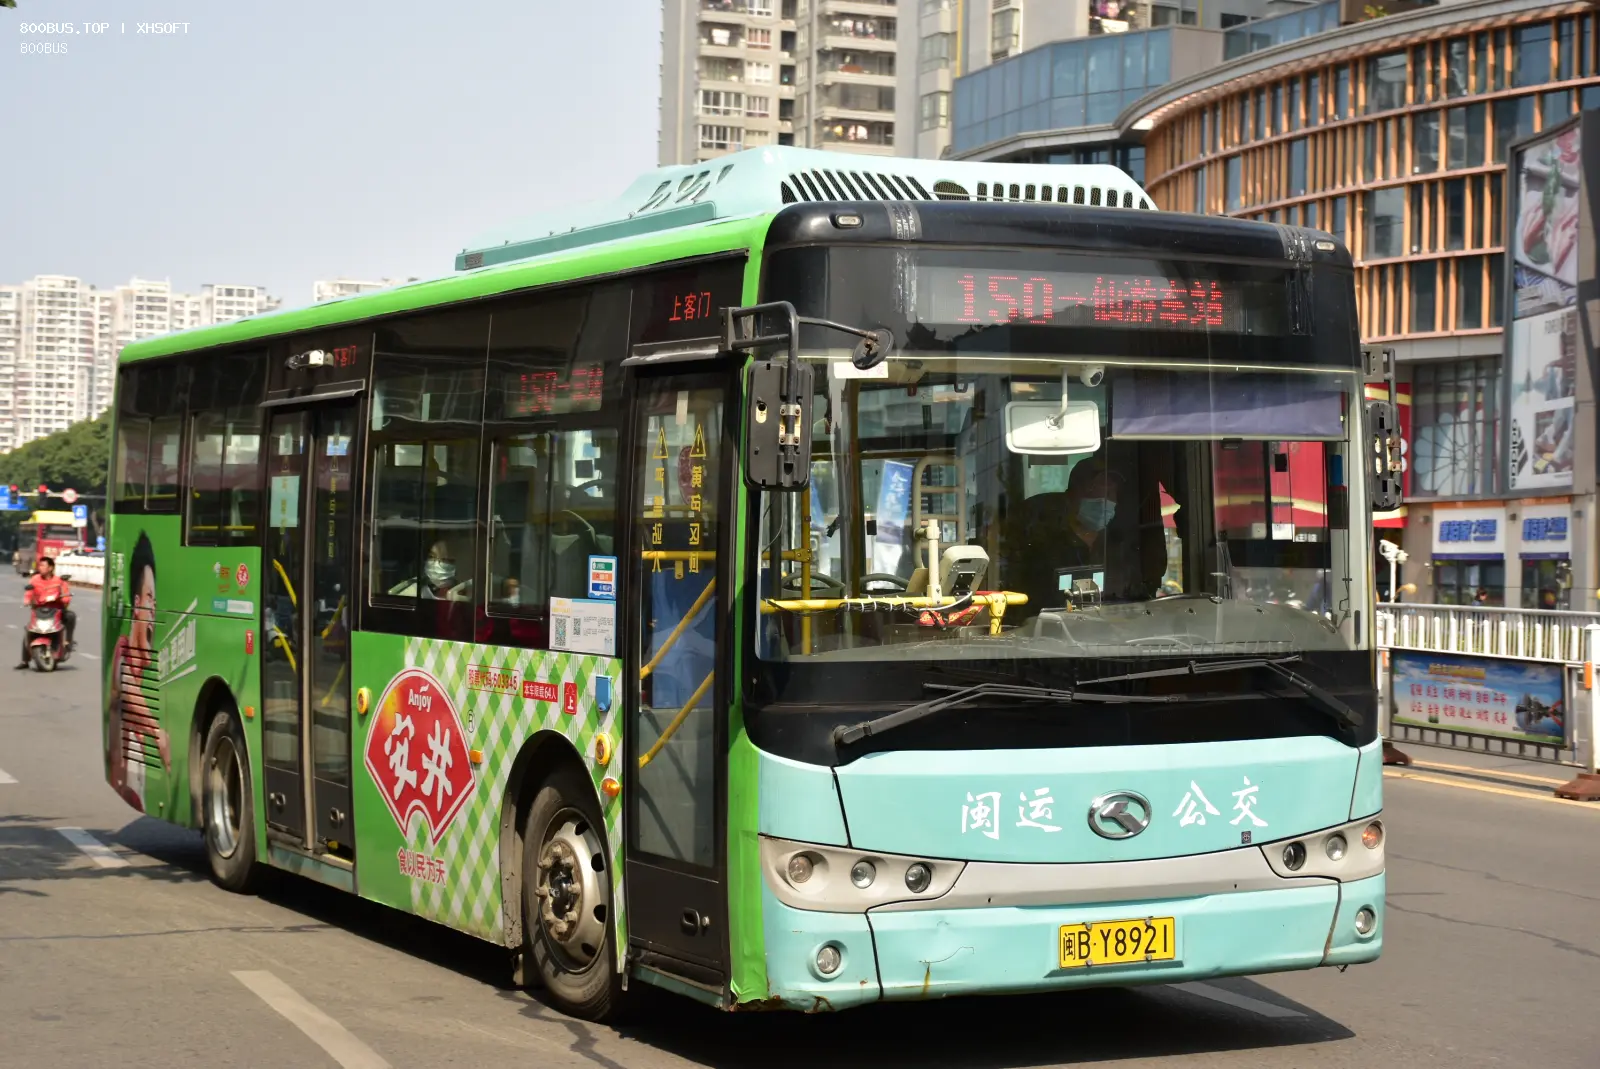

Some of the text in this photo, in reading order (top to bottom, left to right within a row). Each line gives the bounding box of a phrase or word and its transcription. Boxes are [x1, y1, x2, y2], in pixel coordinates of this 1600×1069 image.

[669, 292, 711, 322] 上客门
[957, 274, 1053, 324] 150
[407, 688, 432, 713] Anjoy
[566, 697, 574, 710] 上
[384, 712, 453, 812] 安井
[961, 776, 1269, 840] 闽运 公交
[397, 848, 447, 886] 食以民为天
